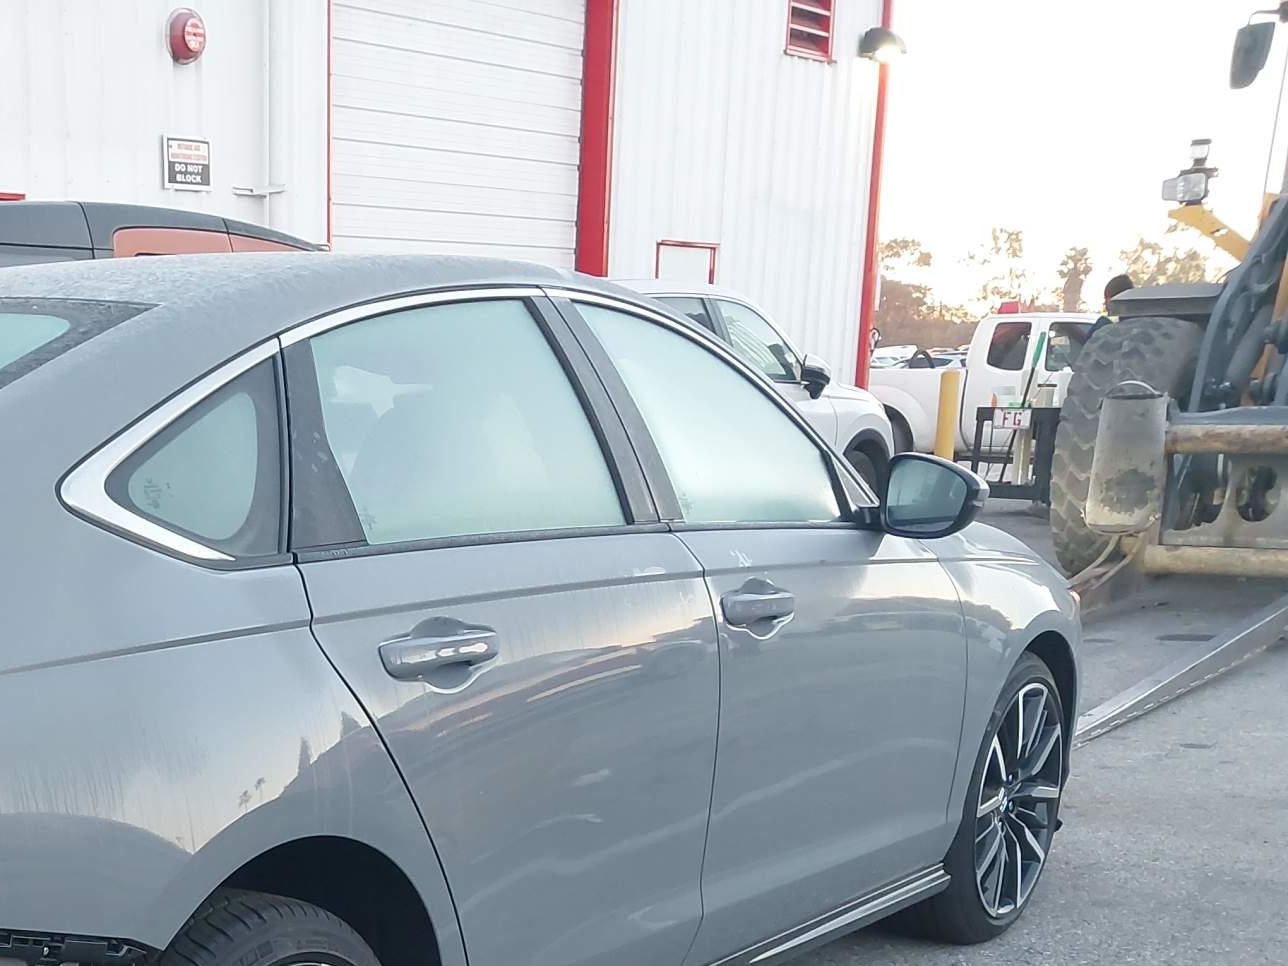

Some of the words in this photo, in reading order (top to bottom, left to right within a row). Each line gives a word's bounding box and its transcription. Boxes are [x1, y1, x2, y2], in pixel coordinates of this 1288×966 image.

[174, 163, 186, 172] DO
[187, 164, 203, 173] NOT
[176, 173, 202, 183] BLOCK
